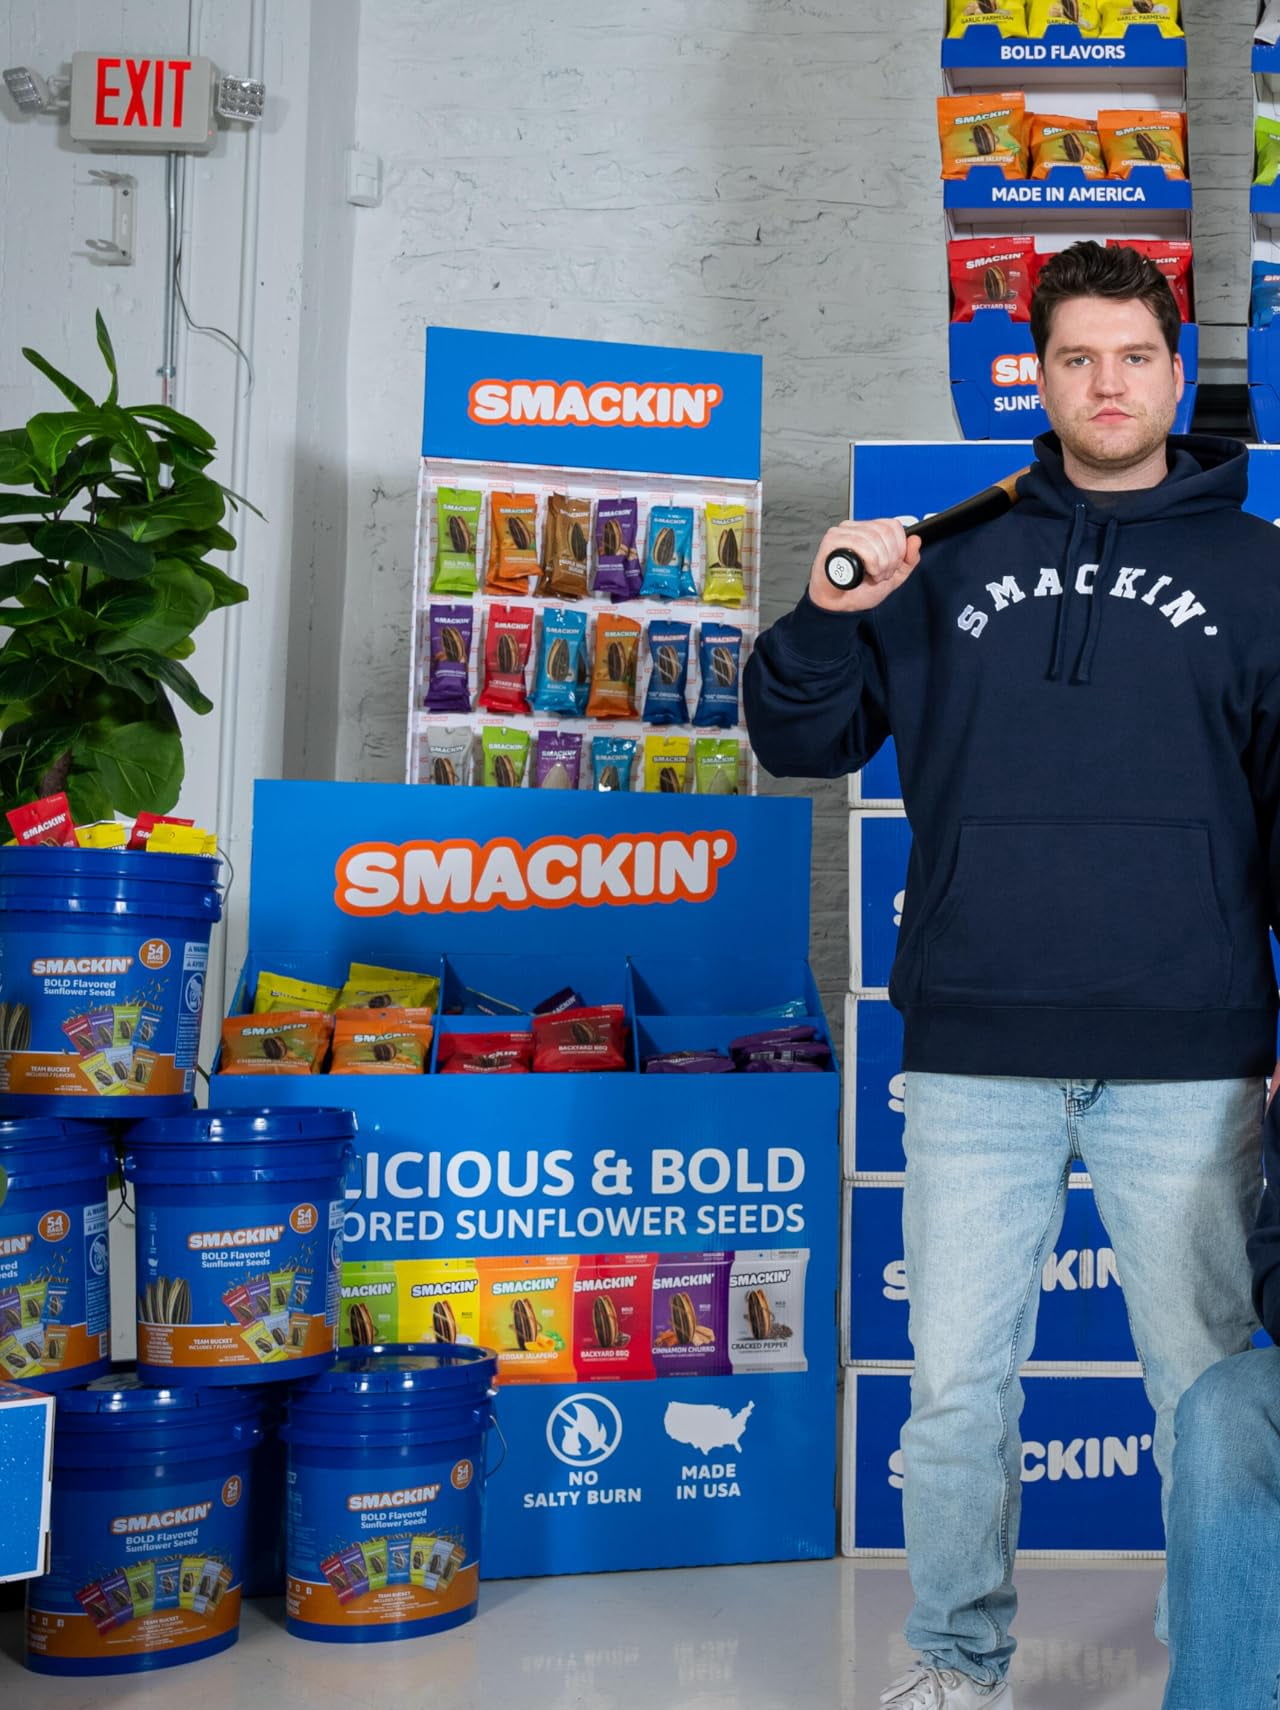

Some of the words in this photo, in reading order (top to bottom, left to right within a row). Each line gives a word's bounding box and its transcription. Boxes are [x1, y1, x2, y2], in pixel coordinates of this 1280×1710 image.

[1000, 46, 1046, 60] BOLD
[1051, 45, 1126, 60] FLAVORS
[95, 59, 191, 128] EXIT
[991, 187, 1041, 202] MADE
[1046, 187, 1065, 201] IN
[1068, 187, 1145, 202] AMERICA
[966, 253, 1024, 269] SMACKIN'
[473, 382, 720, 426] SMACKIN'
[23, 814, 66, 839] SMACKIN'
[345, 838, 728, 907] SMACKIN'
[149, 945, 163, 955] 54
[33, 960, 132, 974] SMACKIN'
[44, 979, 70, 987] BOLD
[73, 979, 117, 988] Flavored
[44, 987, 87, 996] Sunflower
[89, 988, 115, 997] Seeds
[344, 1149, 575, 1199] ICIOUS
[592, 1149, 632, 1195] &
[652, 1147, 805, 1193] BOLD
[298, 1209, 312, 1219] 54
[47, 1217, 63, 1227] 54
[343, 1210, 444, 1243] ORED
[456, 1205, 685, 1240] SUNFLOWER
[697, 1204, 804, 1233] SEEDS
[189, 1227, 285, 1248] SMACKIN'
[202, 1252, 227, 1260] BOLD
[230, 1250, 270, 1259] Flavored
[202, 1260, 244, 1268] Sunflower
[246, 1258, 270, 1266] Seeds
[492, 1278, 558, 1294] SMACKIN'
[574, 1275, 637, 1292] SMACKIN'
[653, 1273, 715, 1289] SMACKIN'
[730, 1271, 790, 1287] SMACKIN'
[340, 1283, 396, 1298] MACKIN'
[412, 1280, 477, 1297] SMACKIN'
[581, 1350, 614, 1358] BACKYARD
[616, 1350, 629, 1358] BBQ
[652, 1346, 687, 1354] CINNAMON
[689, 1345, 716, 1353] CHURRO
[457, 1465, 468, 1475] 54
[681, 1463, 736, 1480] MADE
[569, 1471, 598, 1486] NO
[349, 1486, 440, 1510] SMACKIN'
[677, 1485, 697, 1499] IN
[703, 1482, 741, 1498] USA
[524, 1490, 582, 1509] SALTY
[588, 1488, 641, 1505] BURN
[113, 1505, 211, 1532] SMACKIN'
[361, 1513, 385, 1521] BOLD
[388, 1509, 427, 1521] Flavored
[361, 1519, 406, 1529] Sunflower
[408, 1517, 427, 1526] Seeds
[126, 1533, 153, 1544] BOLD
[157, 1529, 198, 1542] Flavored
[126, 1541, 171, 1553] Sunflower
[174, 1538, 198, 1549] Seeds
